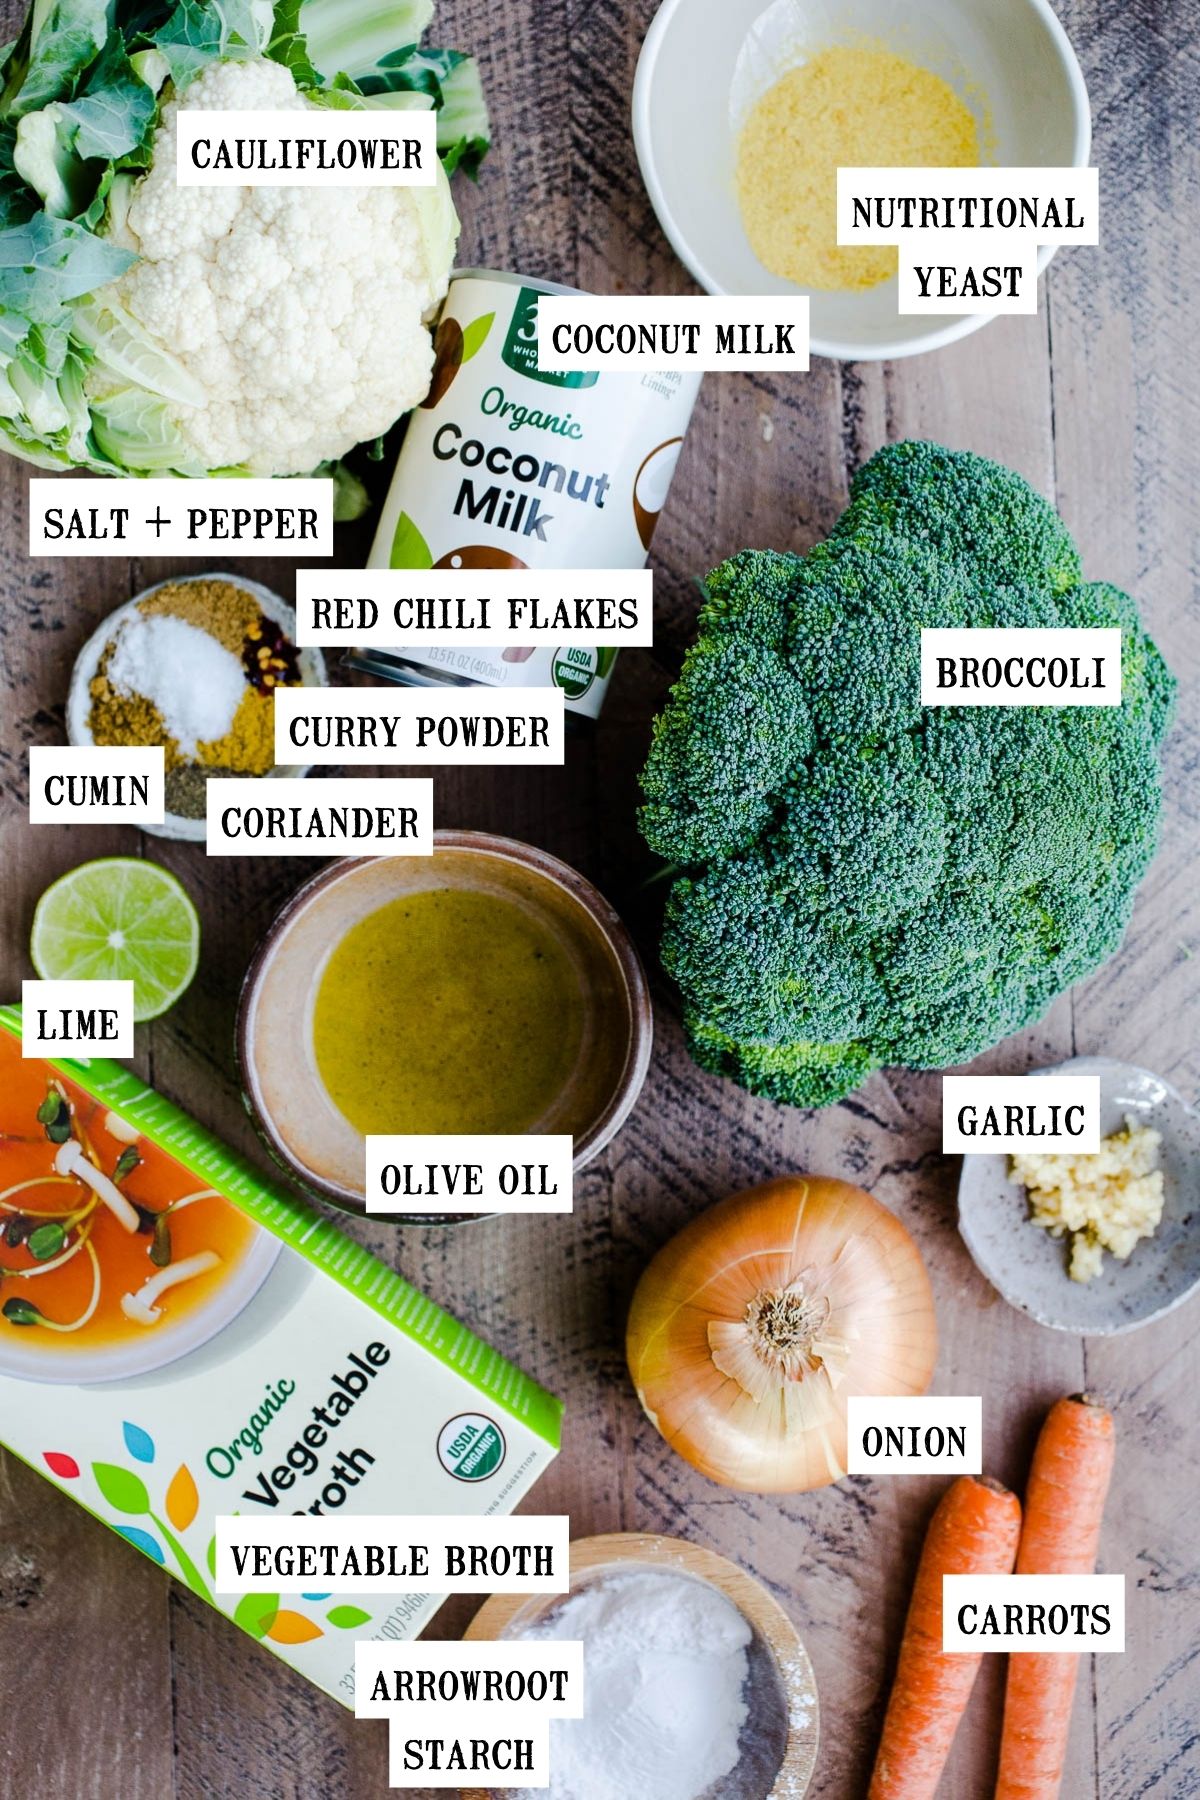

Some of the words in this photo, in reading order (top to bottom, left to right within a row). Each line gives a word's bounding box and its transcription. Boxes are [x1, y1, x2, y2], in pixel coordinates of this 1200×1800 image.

[481, 386, 583, 440] Organic
[432, 422, 610, 509] Coconut
[453, 478, 554, 542] Milk
[558, 666, 590, 685] ORGANIC
[567, 648, 592, 667] USDA
[205, 1379, 296, 1479] Organic
[241, 1341, 391, 1508] Vegetable
[447, 1424, 480, 1459] USDA
[460, 1432, 497, 1474] ORGANIC
[498, 1450, 537, 1500] SUGGESTION
[291, 1447, 376, 1516] roth
